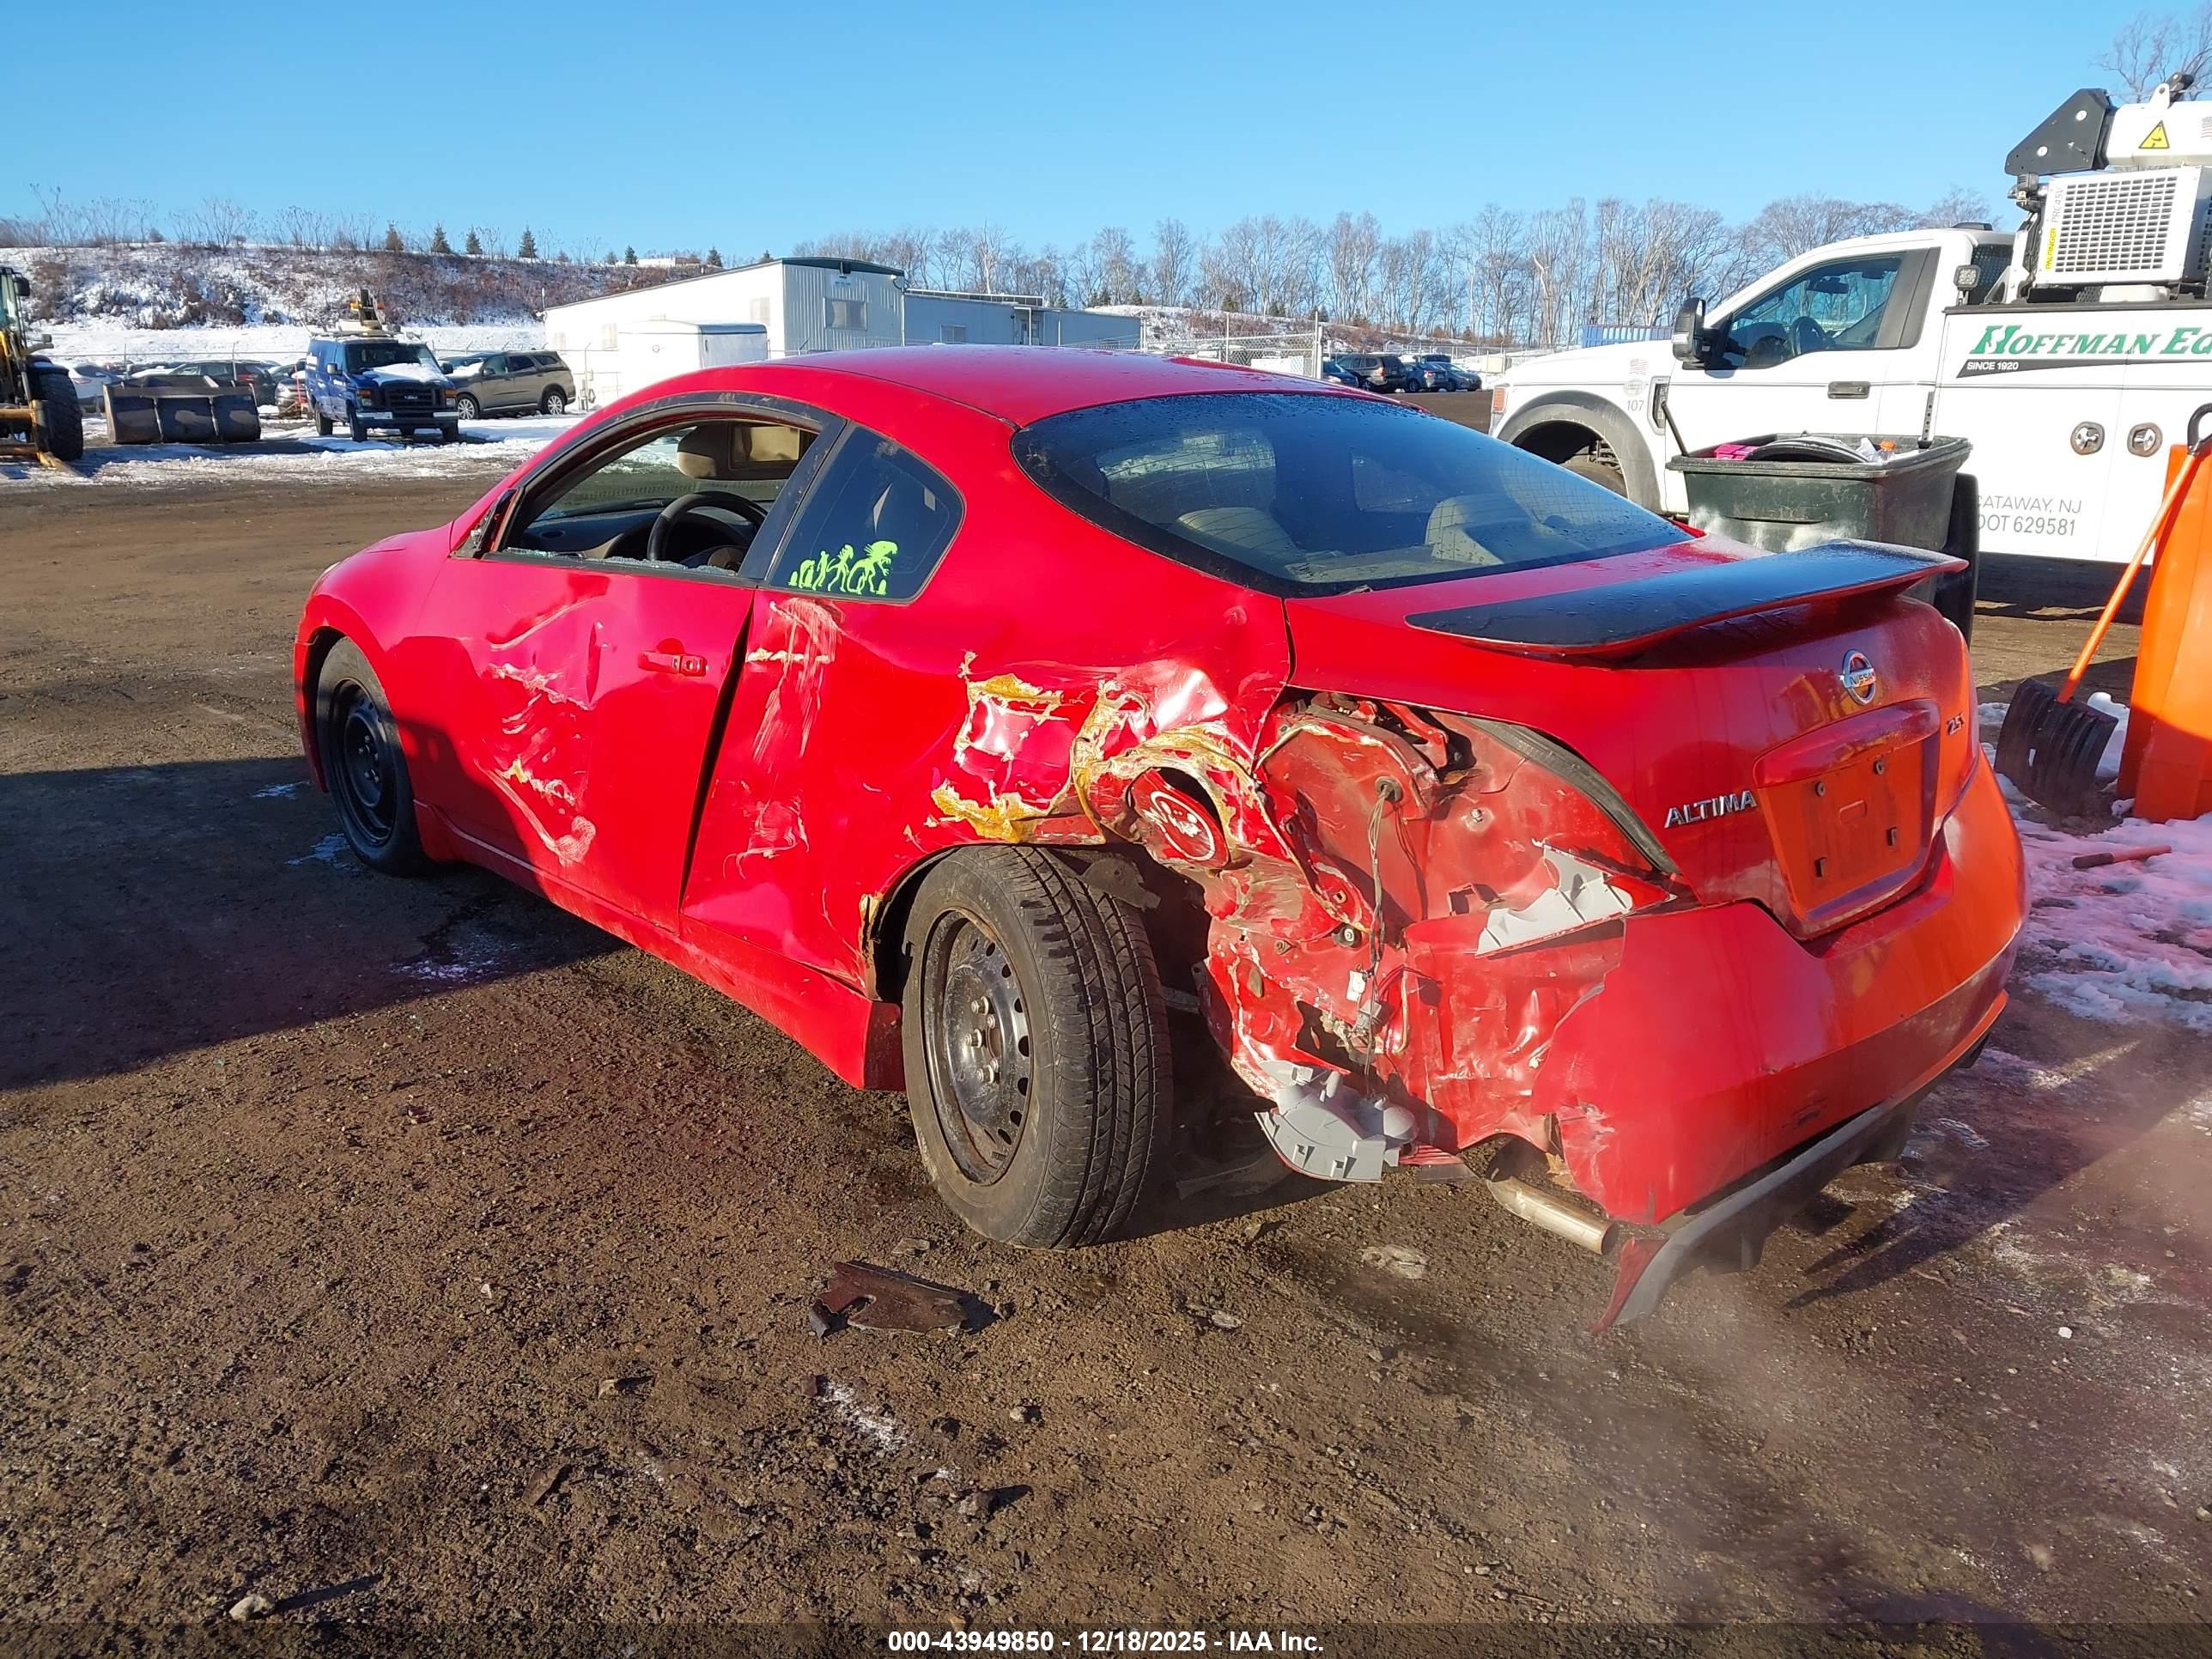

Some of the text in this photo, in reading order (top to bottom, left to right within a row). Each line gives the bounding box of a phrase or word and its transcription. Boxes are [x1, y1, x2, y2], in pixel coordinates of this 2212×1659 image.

[1969, 325, 2161, 354] HOFFMAN
[1966, 361, 2020, 371] SINCE 1920
[1627, 398, 1644, 412] 107
[2058, 499, 2082, 514] NJ
[2013, 515, 2075, 536] 629581
[1664, 789, 1758, 829] ALTIMA
